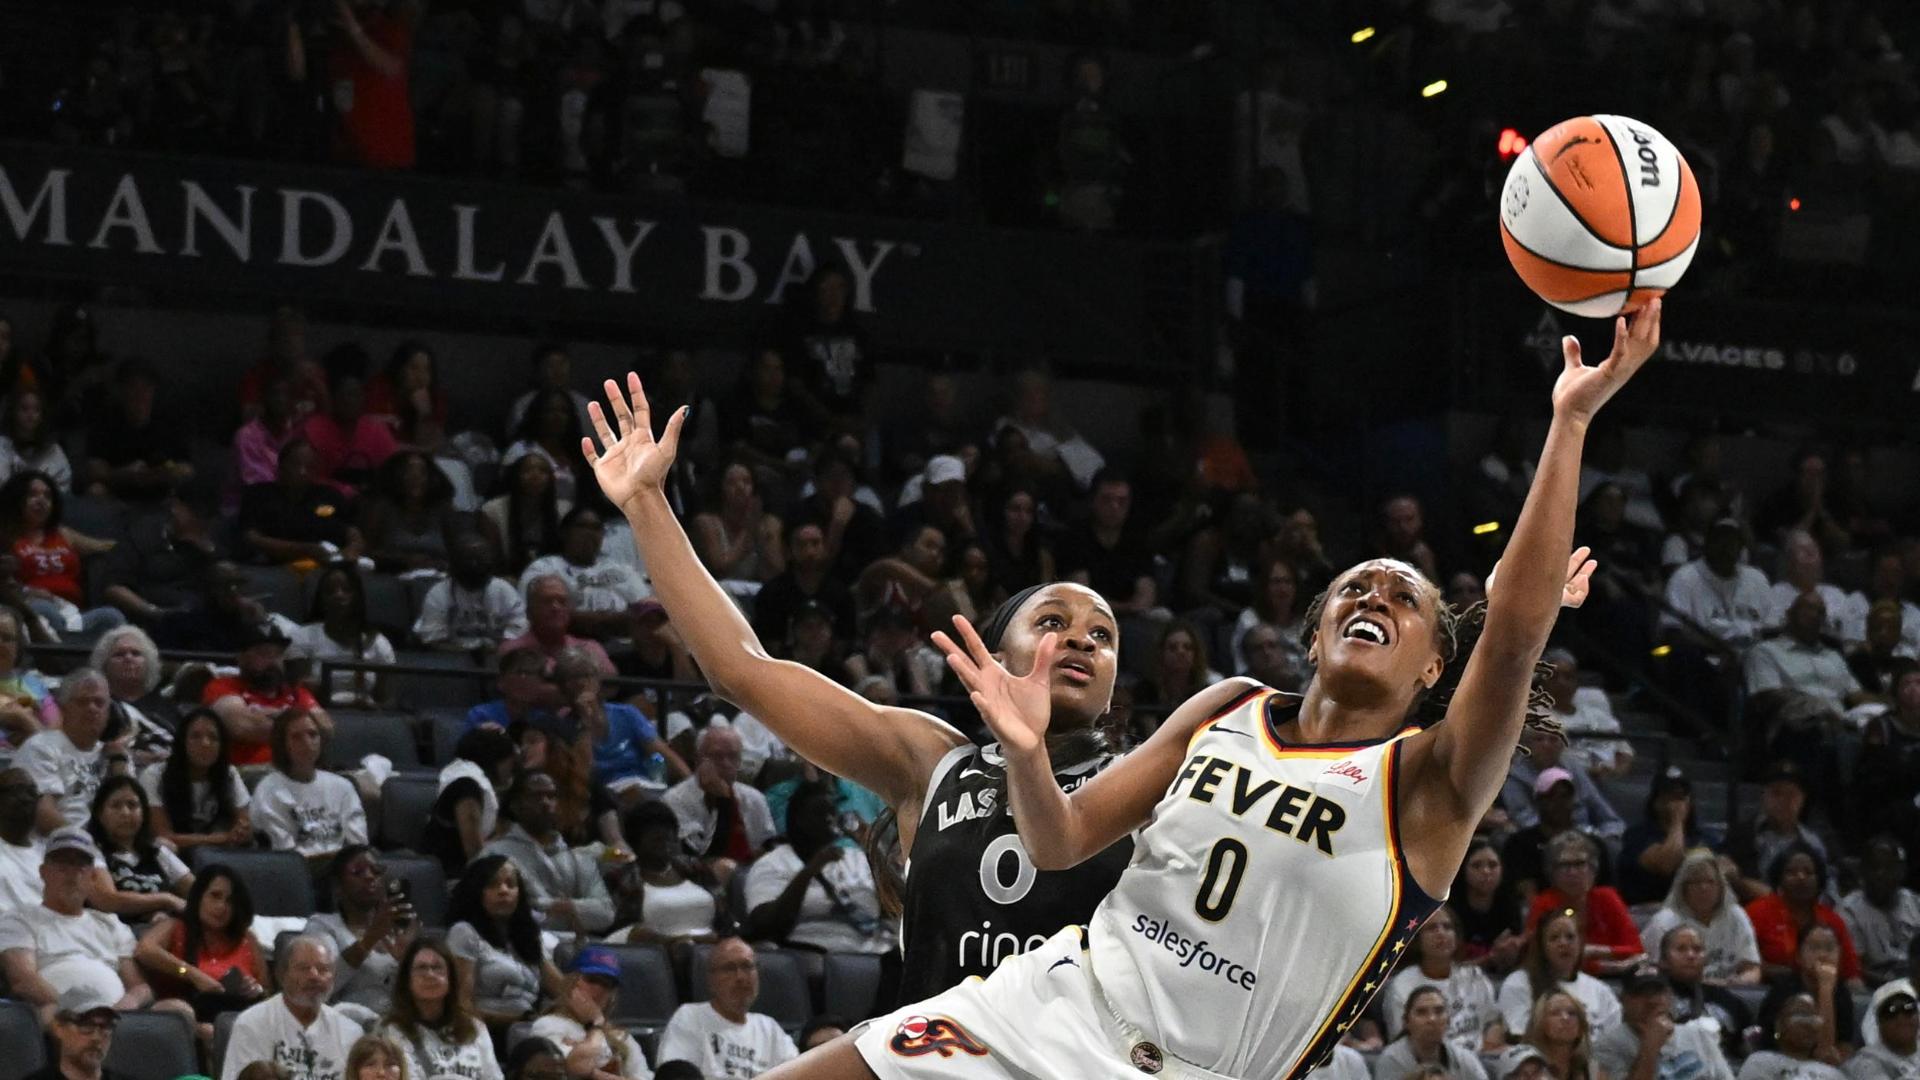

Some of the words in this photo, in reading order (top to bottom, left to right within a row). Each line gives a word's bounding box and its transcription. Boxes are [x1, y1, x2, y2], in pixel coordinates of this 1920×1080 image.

[0, 163, 658, 294] MANDALAY
[699, 232, 896, 312] BAY
[938, 788, 998, 832] LAS
[1171, 756, 1346, 855] FEVER
[980, 833, 1037, 905] 0
[1195, 837, 1248, 922] 0
[1131, 913, 1256, 991] salesforce
